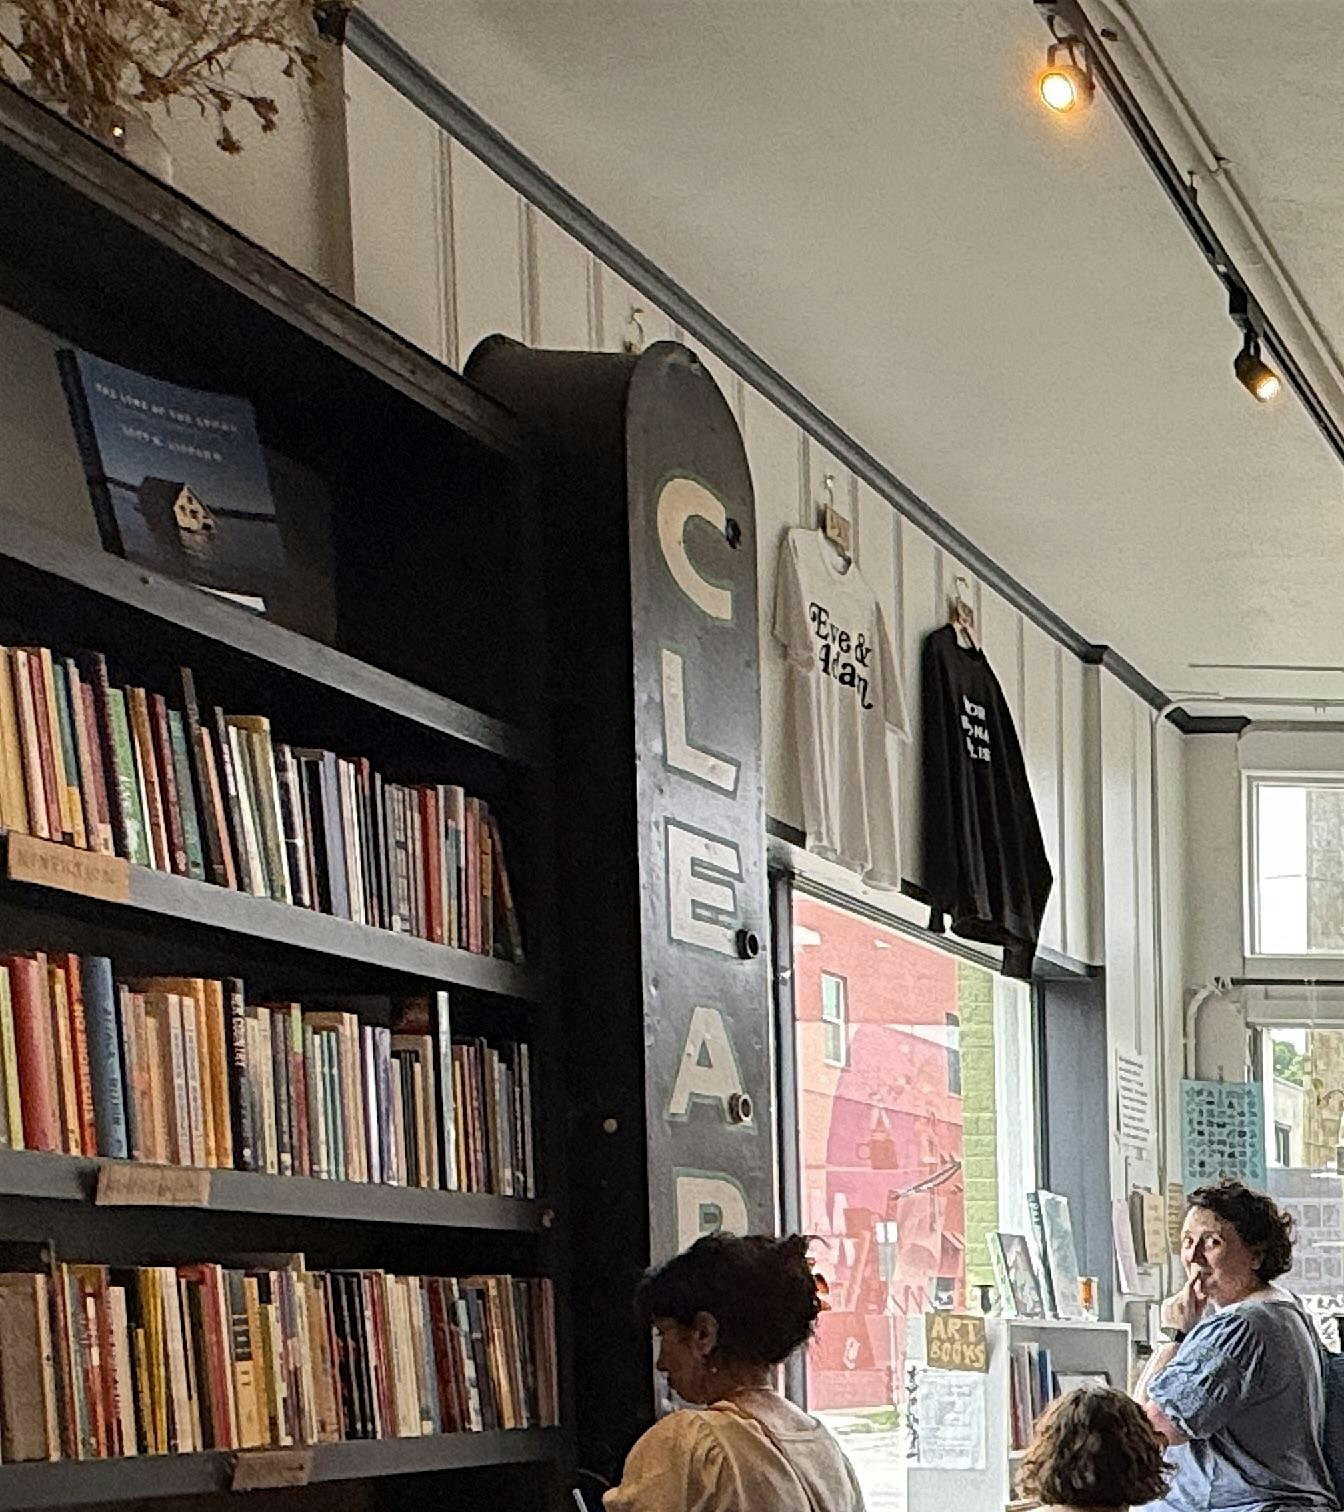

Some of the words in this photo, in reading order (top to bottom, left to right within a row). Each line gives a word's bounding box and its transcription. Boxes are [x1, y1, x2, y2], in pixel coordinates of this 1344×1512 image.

[809, 602, 852, 654] Eve
[931, 1315, 980, 1344] ART
[930, 1340, 986, 1368] BOOKS
